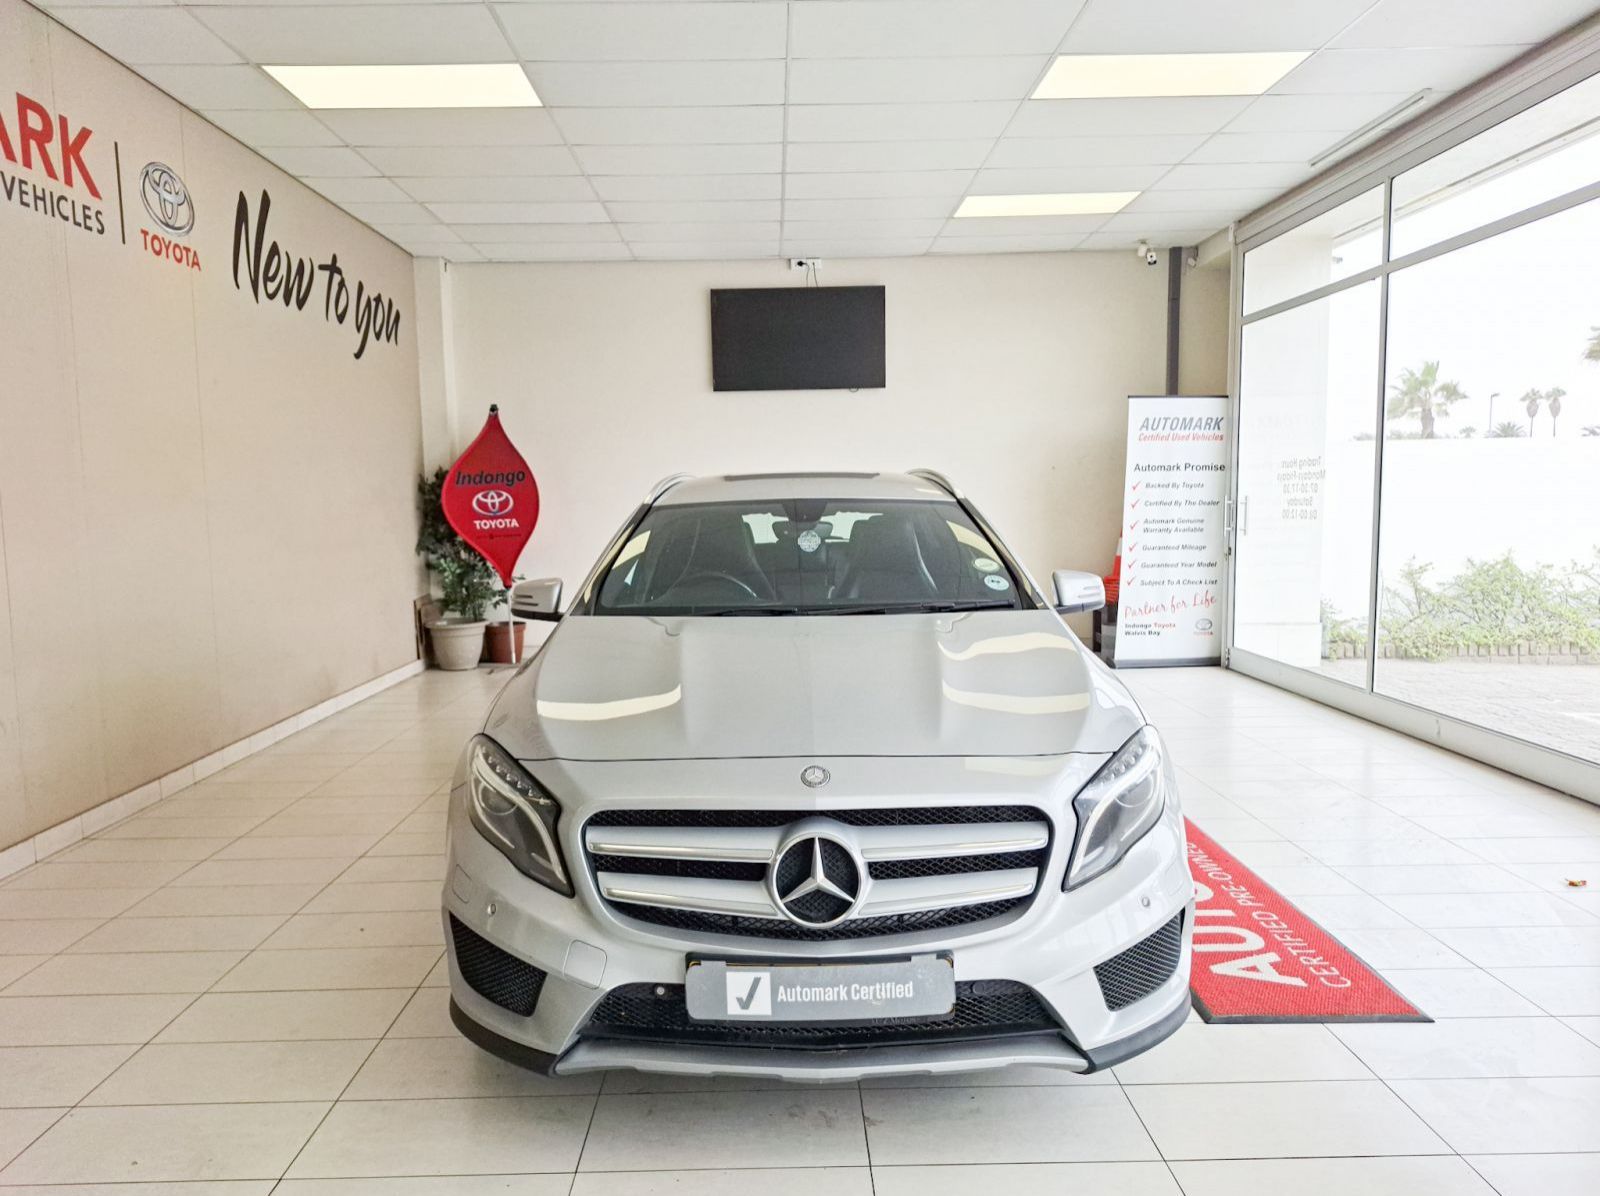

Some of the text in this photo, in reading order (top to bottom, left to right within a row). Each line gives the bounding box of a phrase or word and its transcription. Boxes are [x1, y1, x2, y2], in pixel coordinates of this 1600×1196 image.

[0, 170, 105, 235] VEHICLES
[141, 228, 201, 271] TOYOTA
[232, 189, 401, 360] New to you
[1139, 417, 1224, 431] AUTOMARK
[1138, 433, 1224, 441] Certified Used Vehicles
[1134, 462, 1226, 472] Automark Promise
[455, 470, 526, 487] Indongo
[1171, 482, 1180, 490] By
[1182, 482, 1205, 490] Toyota
[1173, 500, 1183, 508] By
[473, 518, 520, 530] TOYOTA
[1181, 544, 1207, 552] Mileage
[1140, 561, 1179, 569] Guaranteed
[1140, 579, 1166, 587] Subject
[1124, 590, 1217, 619] Partner for Life
[1124, 622, 1152, 630] Indongo
[1252, 910, 1352, 988] CERTIFIED
[777, 980, 914, 1003] Automark Certified
